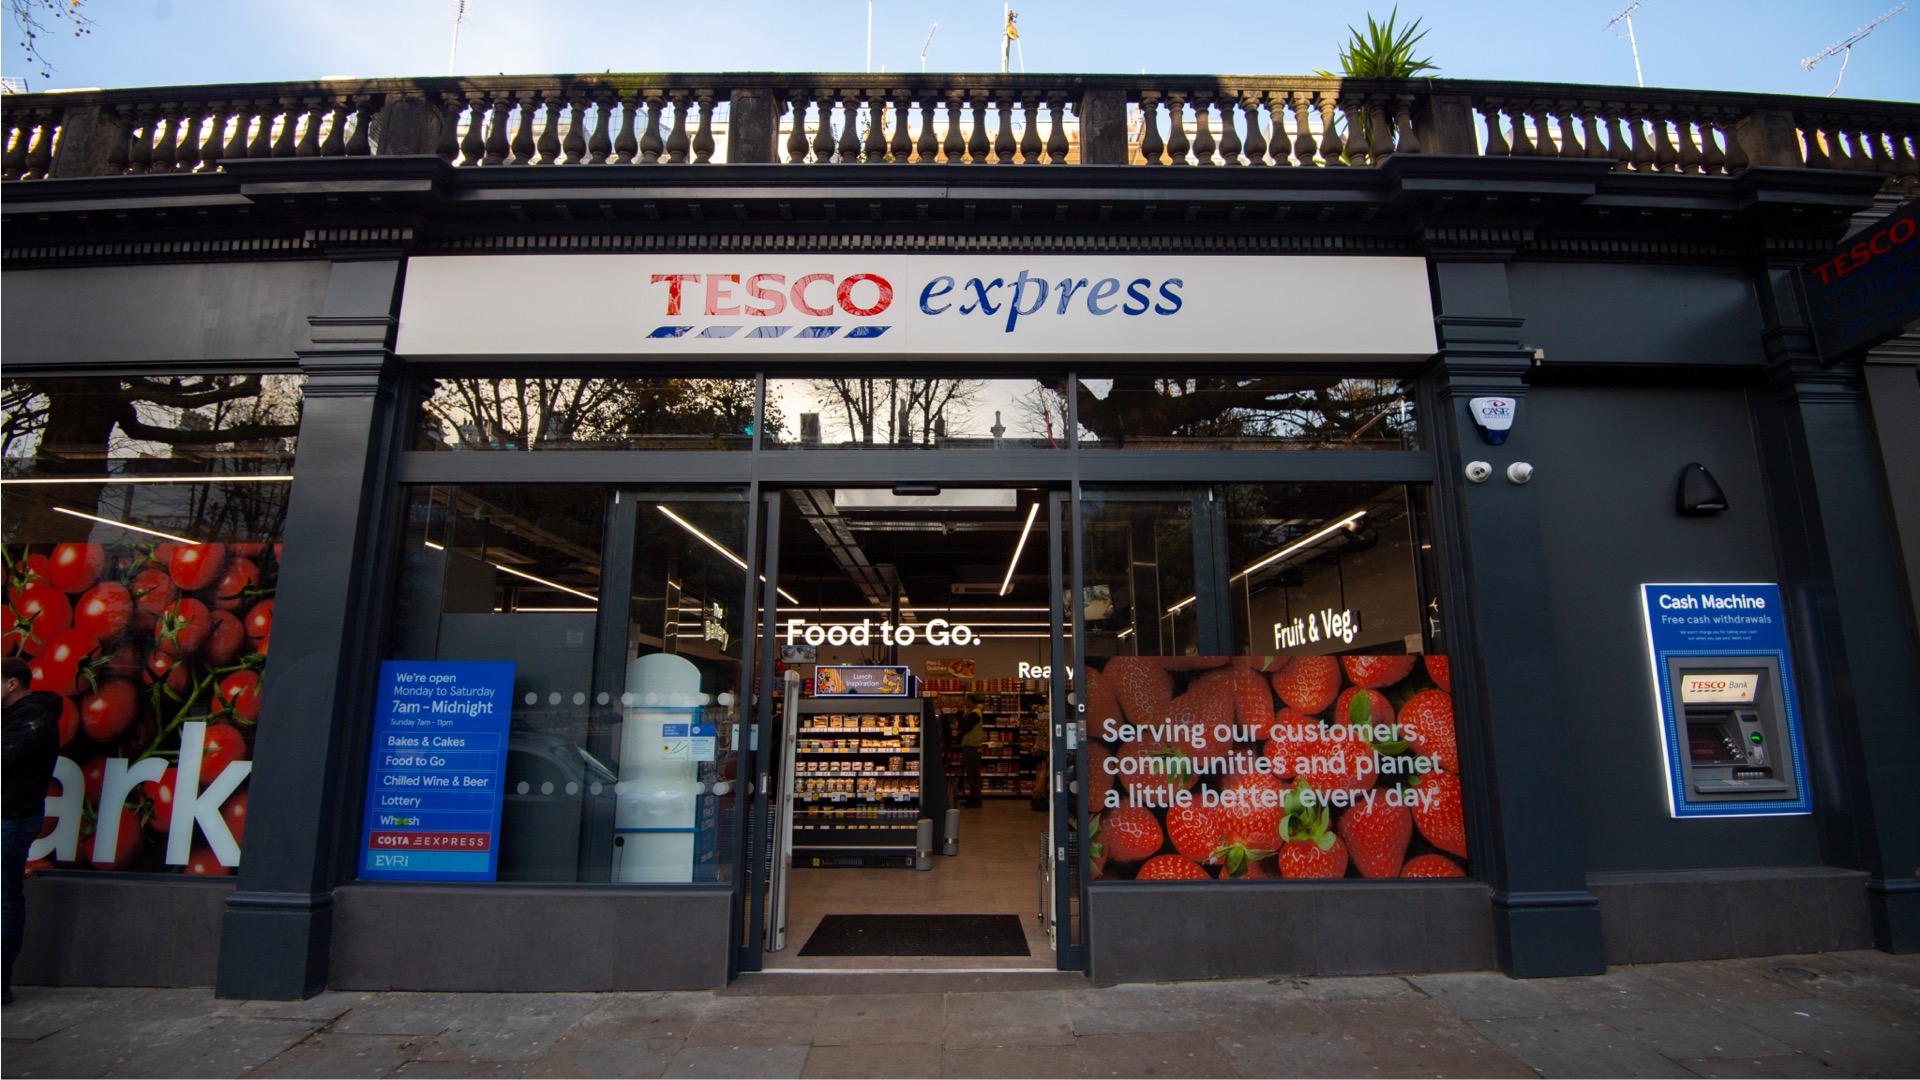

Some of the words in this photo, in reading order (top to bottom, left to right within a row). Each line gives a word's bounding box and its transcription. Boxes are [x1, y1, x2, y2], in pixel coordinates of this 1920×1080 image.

[1812, 217, 1916, 285] TESCO
[651, 273, 893, 317] TESCO
[919, 269, 1184, 333] express
[1482, 407, 1510, 415] CASE
[1659, 594, 1698, 609] Cash
[1661, 615, 1685, 624] Free
[1687, 615, 1710, 624] cash
[1712, 614, 1772, 624] withdrawals
[787, 619, 870, 646] Food
[880, 623, 915, 646] to
[925, 619, 981, 646] Go.
[1274, 617, 1306, 650] Fruit
[1308, 612, 1319, 643] &
[1321, 607, 1358, 645] Veg.
[1018, 661, 1074, 680] Reay
[396, 673, 427, 683] We're
[428, 675, 456, 685] open
[1690, 681, 1726, 689] TESCO
[1729, 681, 1748, 689] Bank
[393, 686, 434, 698] Monday
[436, 687, 447, 696] to
[450, 686, 495, 698] Saturday
[392, 700, 420, 713] 7am
[431, 700, 493, 717] Midnight
[390, 719, 416, 727] Sunday
[436, 719, 454, 727] 11pm
[1102, 717, 1207, 749] Serving
[1213, 723, 1262, 743] our
[1269, 719, 1426, 746] customers,
[387, 736, 419, 746] Bakes
[421, 737, 430, 746] &
[432, 737, 466, 747] Cakes
[385, 756, 414, 766] Food
[415, 757, 428, 766] to
[429, 757, 446, 766] Go
[1102, 749, 1286, 775] communities
[1294, 749, 1346, 775] and
[1355, 749, 1444, 781] planet
[383, 775, 421, 786] Chilled
[422, 776, 450, 786] Wine
[452, 776, 461, 787] &
[463, 777, 489, 787] Beer
[381, 796, 421, 808] Lottery
[1104, 788, 1120, 808] a
[1128, 782, 1193, 808] little
[1201, 782, 1292, 808] better
[1299, 788, 1377, 814] every
[1384, 782, 1441, 814] day.
[380, 815, 420, 826] Whoosh
[377, 836, 409, 846] COSTA
[424, 837, 484, 847] EXPRESS
